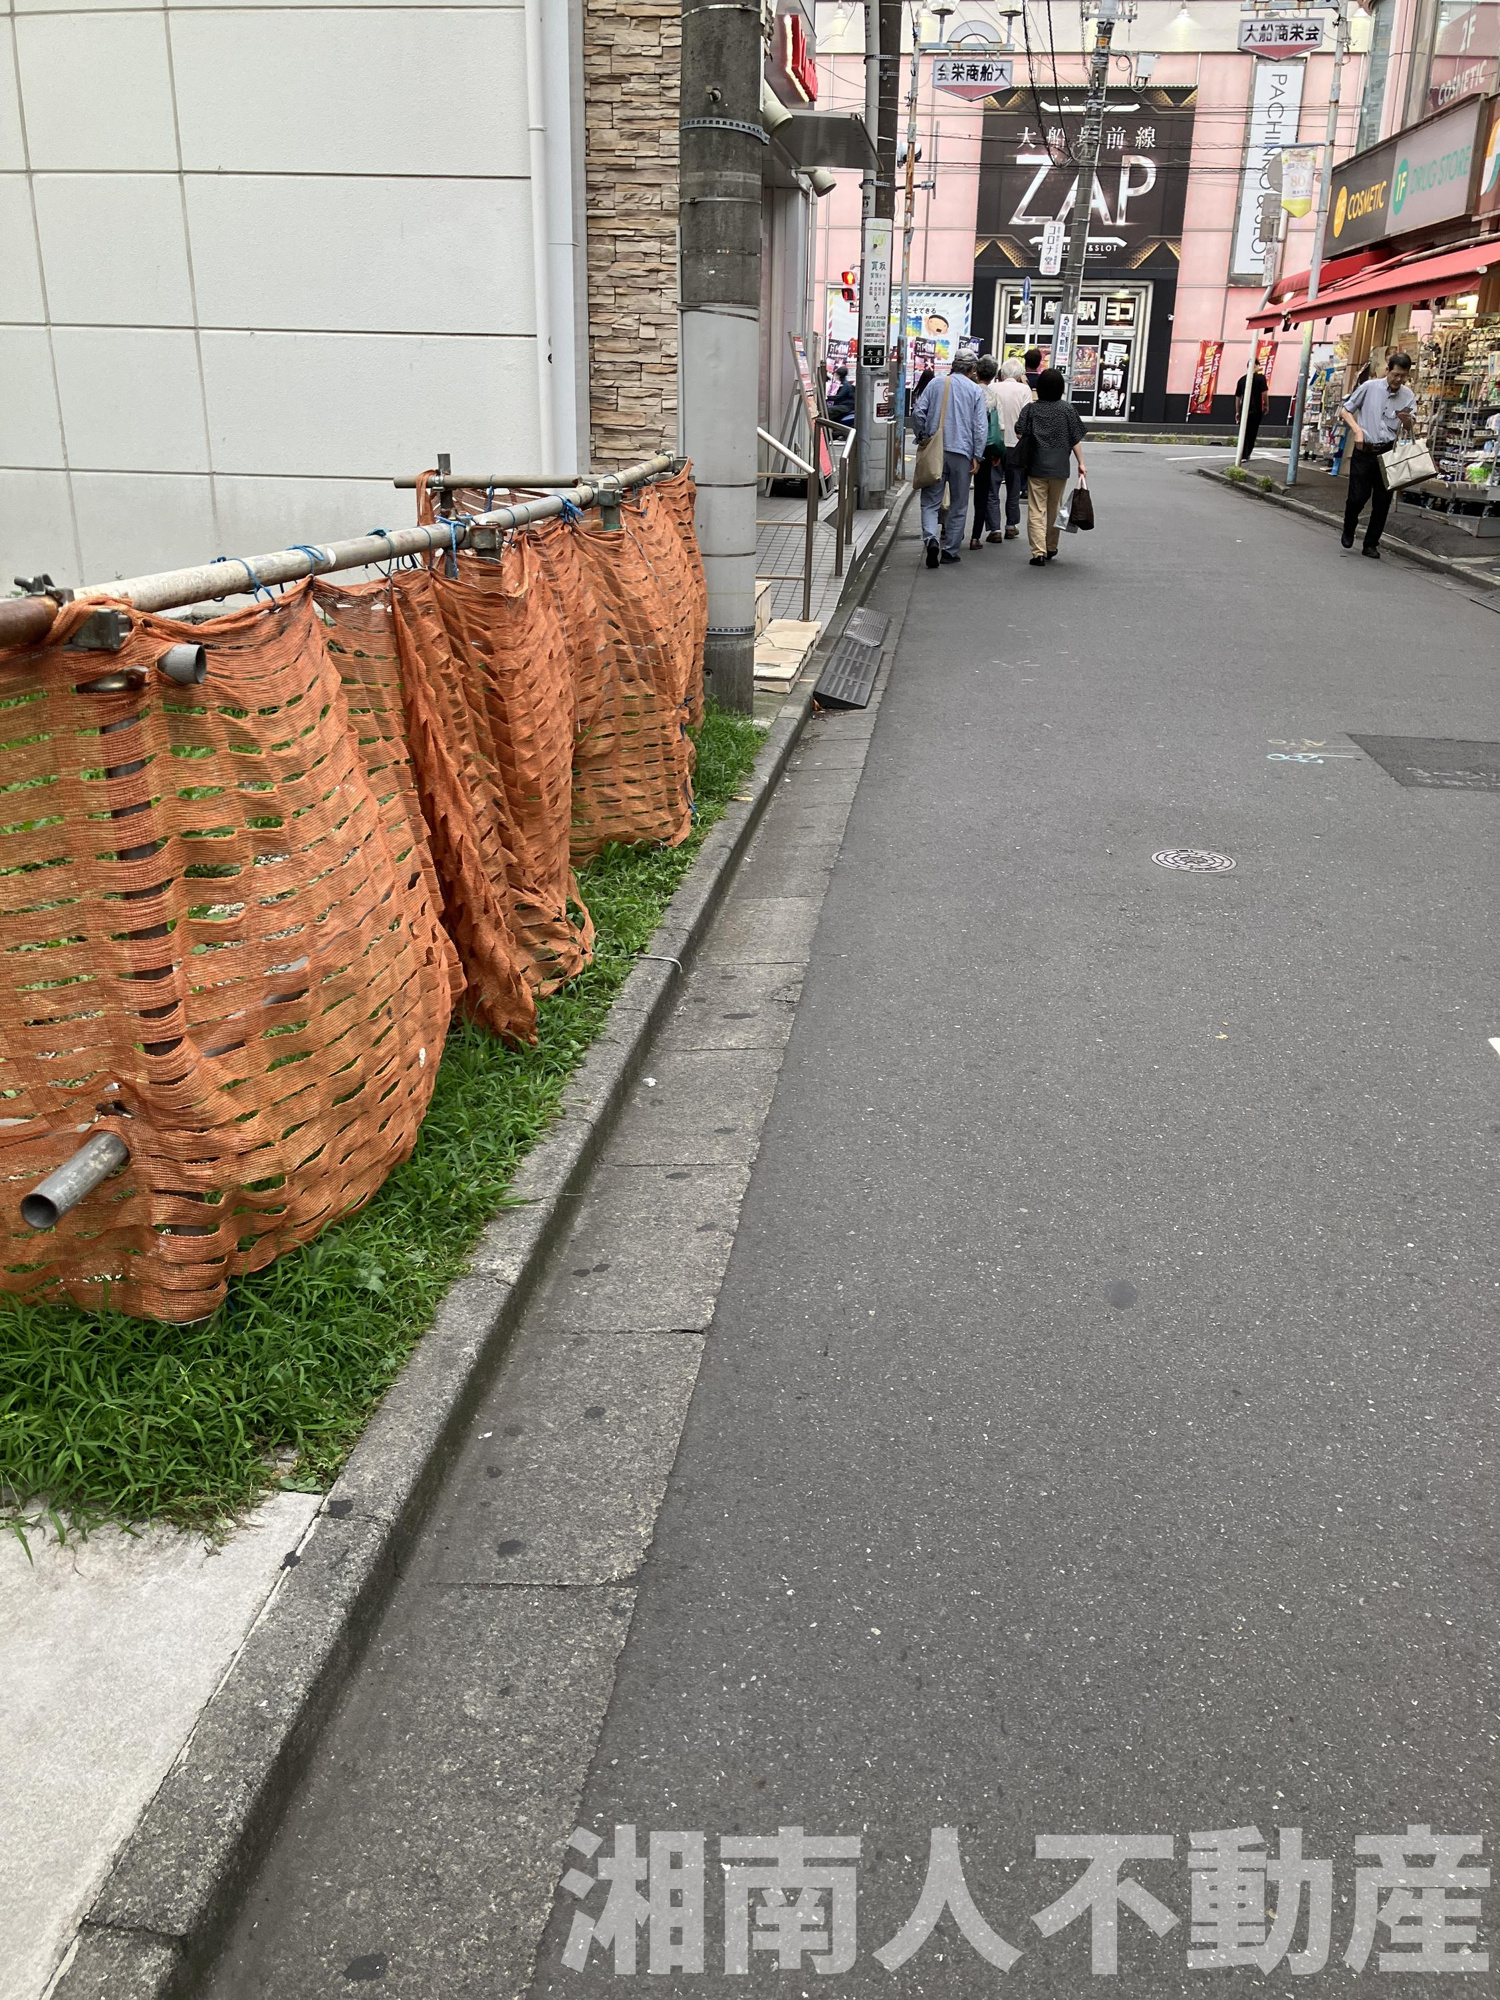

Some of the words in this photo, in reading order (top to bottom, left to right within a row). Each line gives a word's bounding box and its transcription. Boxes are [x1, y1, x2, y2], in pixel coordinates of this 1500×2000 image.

[1244, 22, 1320, 43] 大船商栄会
[1460, 14, 1478, 53] 2F
[1438, 60, 1488, 106] COSMETIC
[1008, 154, 1157, 226] ZAP
[1409, 163, 1439, 196] DRUG
[1438, 145, 1472, 187] STORE
[1346, 180, 1388, 221] COSMETIC
[1044, 225, 1056, 266] コロナ堂
